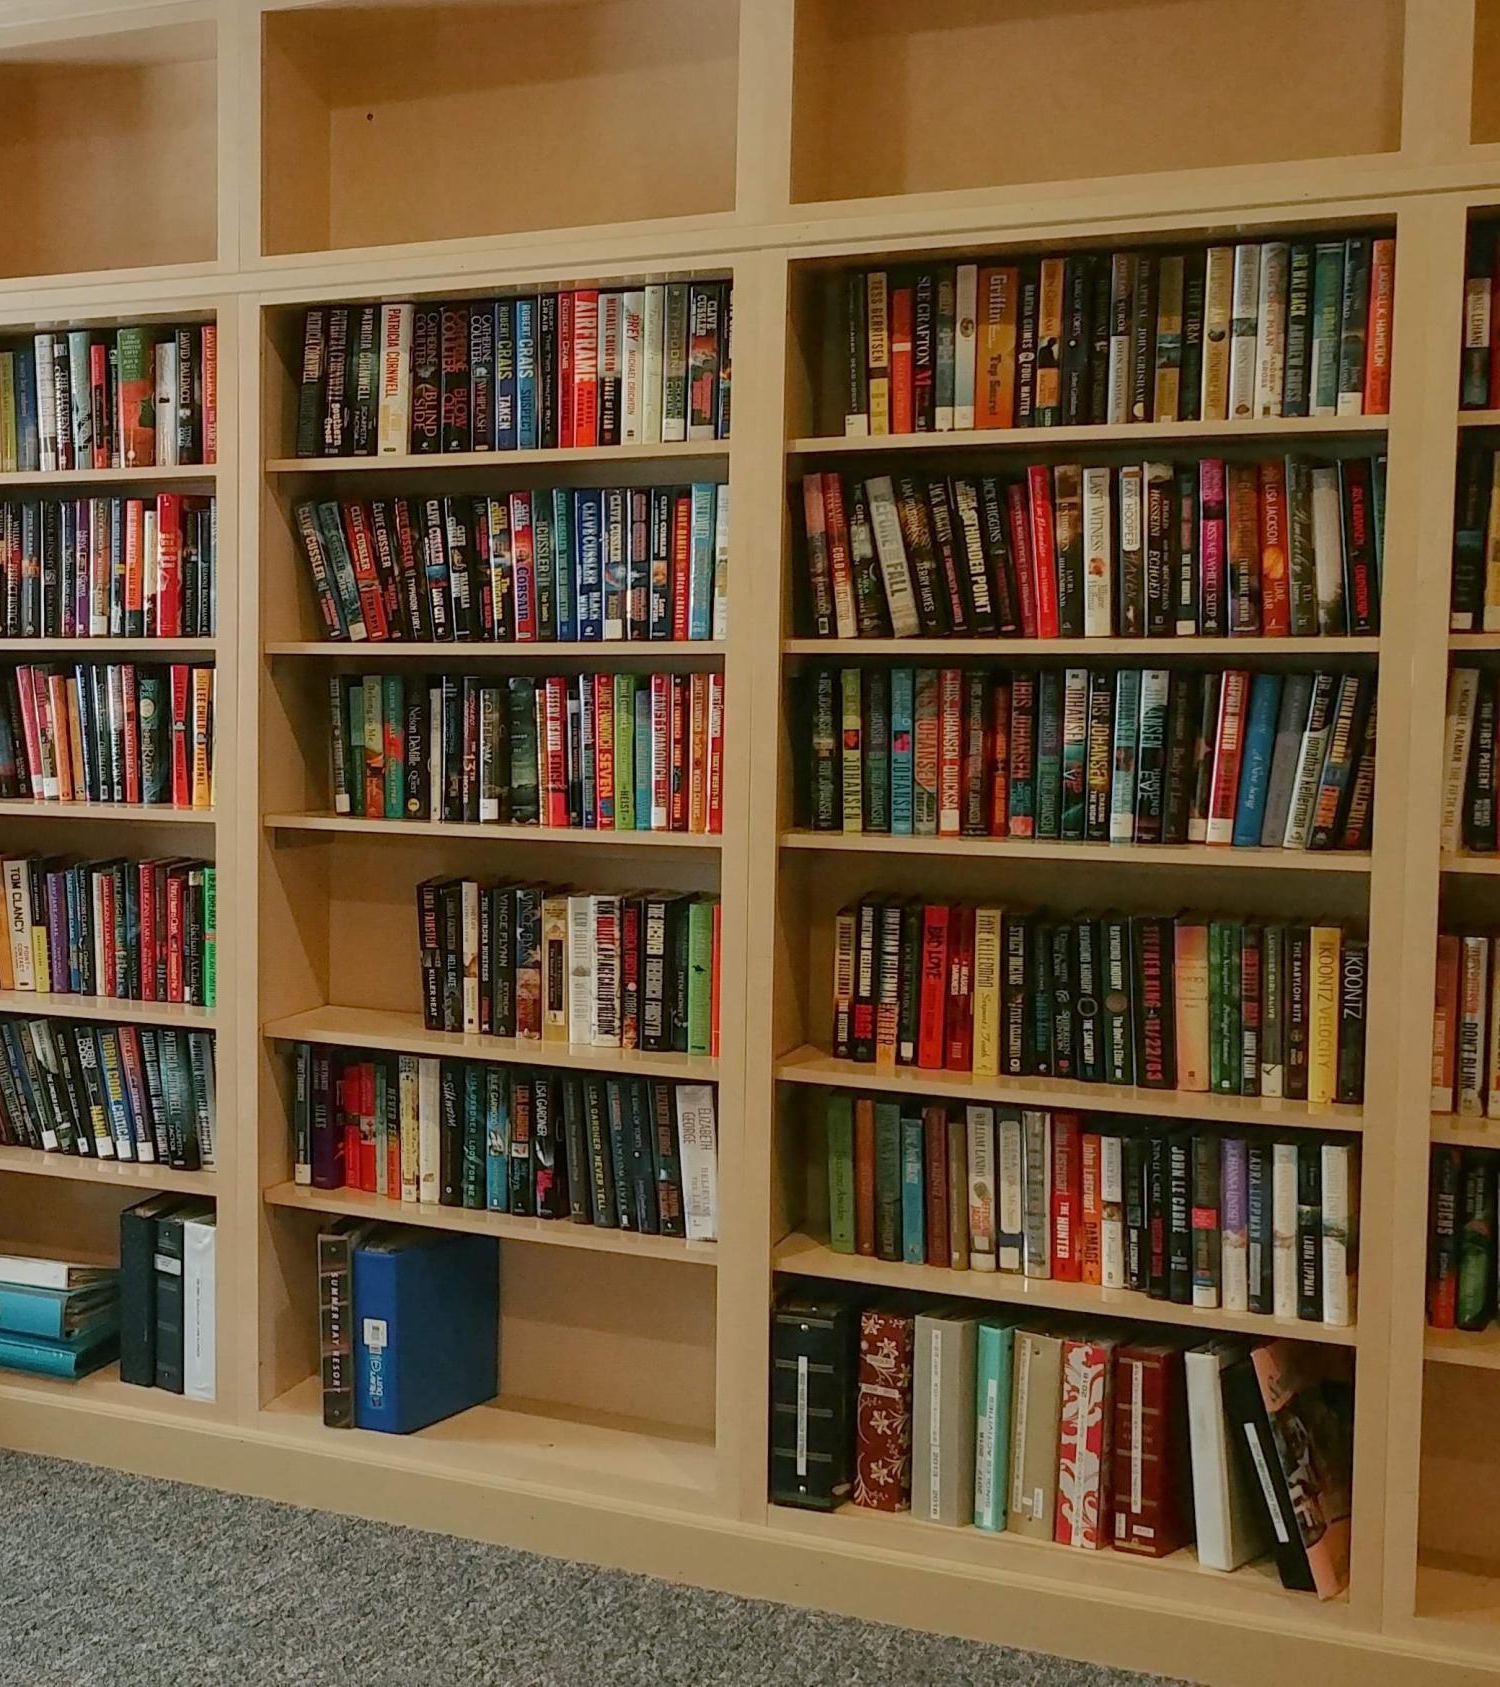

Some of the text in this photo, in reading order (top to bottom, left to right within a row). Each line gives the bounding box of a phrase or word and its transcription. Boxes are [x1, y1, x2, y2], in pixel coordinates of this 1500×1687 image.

[989, 274, 1008, 324] Griffin
[1291, 255, 1309, 317] NO WAY BACK
[414, 314, 426, 365] COULTER
[576, 301, 598, 382] AIRFRAME
[871, 281, 883, 362] TESS GERRITSEN
[915, 275, 930, 366] SUE GRAFTON
[1470, 313, 1484, 346] LEHANE
[180, 332, 190, 404] DAVID BALDACCI
[357, 308, 374, 401] PATRICIA CORNWELL
[385, 308, 401, 399] PATRICIA CORNWELL
[498, 307, 512, 430] ROBERT CRAIS TAKEN
[519, 304, 533, 433] ROBERT CRAIS SUSPECT
[62, 393, 70, 443] ELEVENTH
[413, 398, 425, 431] SIDE
[12, 521, 20, 551] WILLIAM
[298, 507, 326, 581] CLIVE CUSSLER
[350, 506, 371, 571] CLIVE CUSSLER
[372, 503, 391, 568] CLIVE CUSSLER
[582, 502, 598, 585] CLIVE CUSSLER
[1089, 475, 1105, 551] LAST WITNESS
[1150, 489, 1160, 537] HOSSEINI
[1265, 483, 1277, 544] LISA JACKSON
[536, 527, 549, 573] CUSSLER
[886, 561, 909, 597] FALL
[962, 520, 991, 614] THUNDER POINT
[1149, 550, 1160, 598] ECHOED
[196, 688, 206, 729] LEE CHILD
[408, 706, 421, 767] Nelson DeMille
[547, 683, 561, 751] JEFFERY DEAVER
[1012, 681, 1033, 778] IRIS JOHANSEN
[1066, 685, 1085, 746] JOHANSEN
[1090, 691, 1111, 784] IRIS JOHANSEN
[1451, 688, 1470, 762] MICHAEL PALMER
[599, 685, 612, 798] JANET EVANOVICH SEVEN
[1477, 702, 1493, 790] THE FIRST PATIENT
[619, 791, 629, 814] HEIST
[843, 757, 860, 820] JOHANSEN
[893, 758, 910, 822] JOHANSEN
[1293, 735, 1324, 828] jonathan kellerman
[11, 868, 25, 934] TOM CLANCY
[499, 894, 508, 967] VINCE FLYNN
[596, 901, 616, 945] KEN FOLLETT
[646, 903, 665, 955] THE DECEIVER
[17, 943, 25, 972] CONTACT
[859, 906, 873, 997] JONATHAN KELLERMAN
[950, 964, 959, 996] DARKNESS
[1292, 941, 1301, 1023] THE BABYLON RITE
[428, 969, 437, 1016] KILLER HEAT
[625, 991, 637, 1017] COBRA
[1317, 947, 1334, 1069] KOONTZ VELOCITY
[1343, 956, 1363, 1020] KOONTZ
[86, 1038, 97, 1068] ROBIN
[854, 1004, 873, 1039] RAGE
[77, 1039, 91, 1069] COOK
[164, 1031, 181, 1115] PATRICIA CORNWELL
[1461, 1022, 1478, 1091] DON'T BLINK
[89, 1105, 106, 1138] NANO
[192, 1041, 212, 1155] PATRICIA CORNWELL SCARPETTA
[315, 1104, 326, 1128] SILKS
[535, 1080, 547, 1137] LISA GARDNER
[682, 1112, 695, 1145] GEORGE
[698, 1108, 713, 1150] ELIZABETH
[594, 1155, 606, 1211] NEVER TELL
[1083, 1143, 1098, 1265] John Lescroart DAMAGE
[1171, 1146, 1188, 1233] JOHN LE CARRÉ
[1249, 1150, 1262, 1238] LAURA LIPPMAN
[1437, 1193, 1454, 1236] REICHS
[1056, 1201, 1069, 1258] THE HUNTER
[1303, 1235, 1316, 1296] LAURA LIPPMAN
[330, 1272, 341, 1394] SUMMER BAY RESORT
